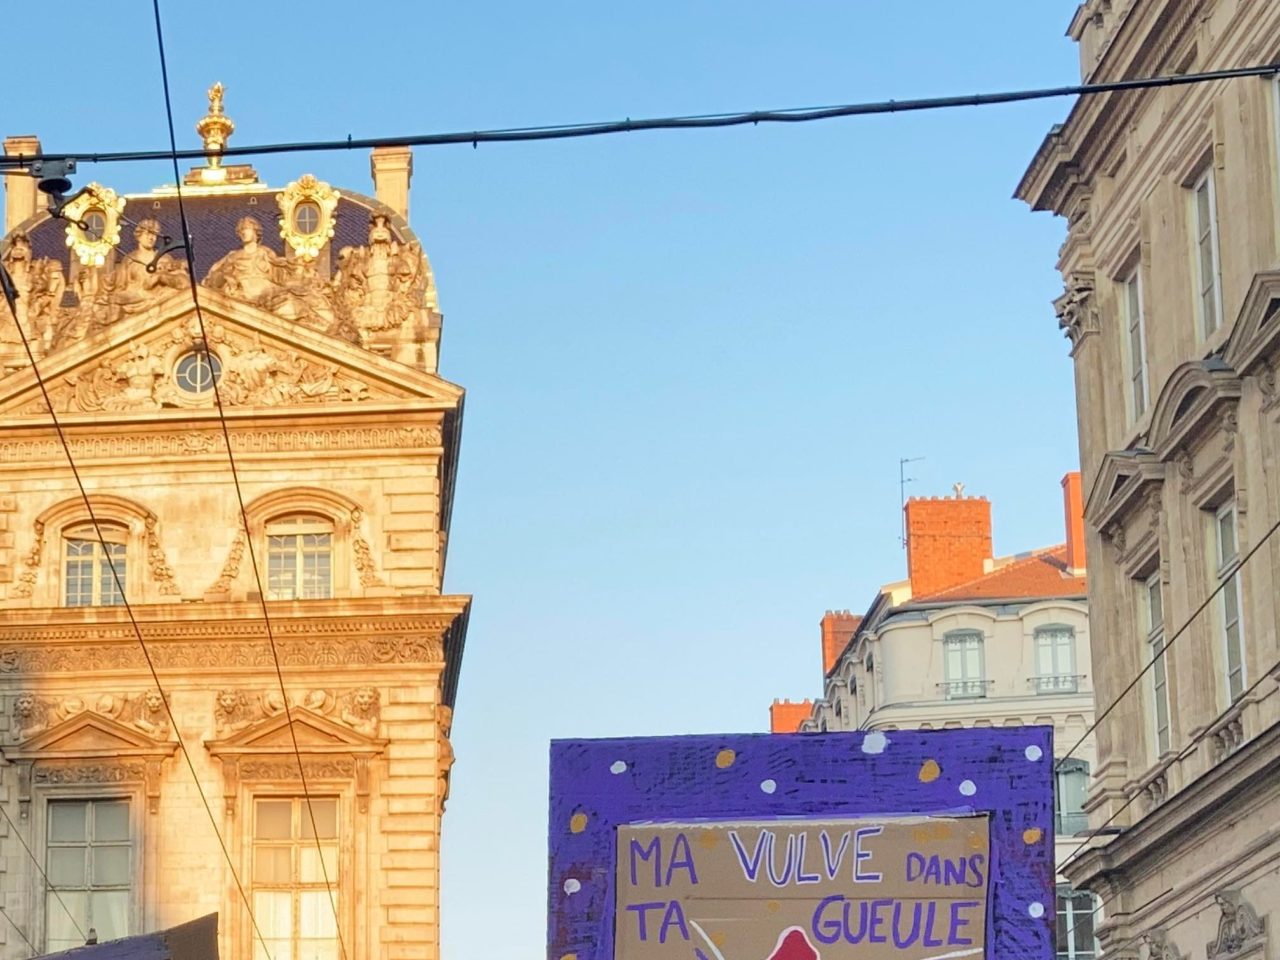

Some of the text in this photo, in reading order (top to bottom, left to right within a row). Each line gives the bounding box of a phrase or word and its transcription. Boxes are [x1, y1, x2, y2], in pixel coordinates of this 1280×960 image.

[631, 825, 983, 888] MA VULVE DANS
[626, 894, 980, 949] TA GUEULE
